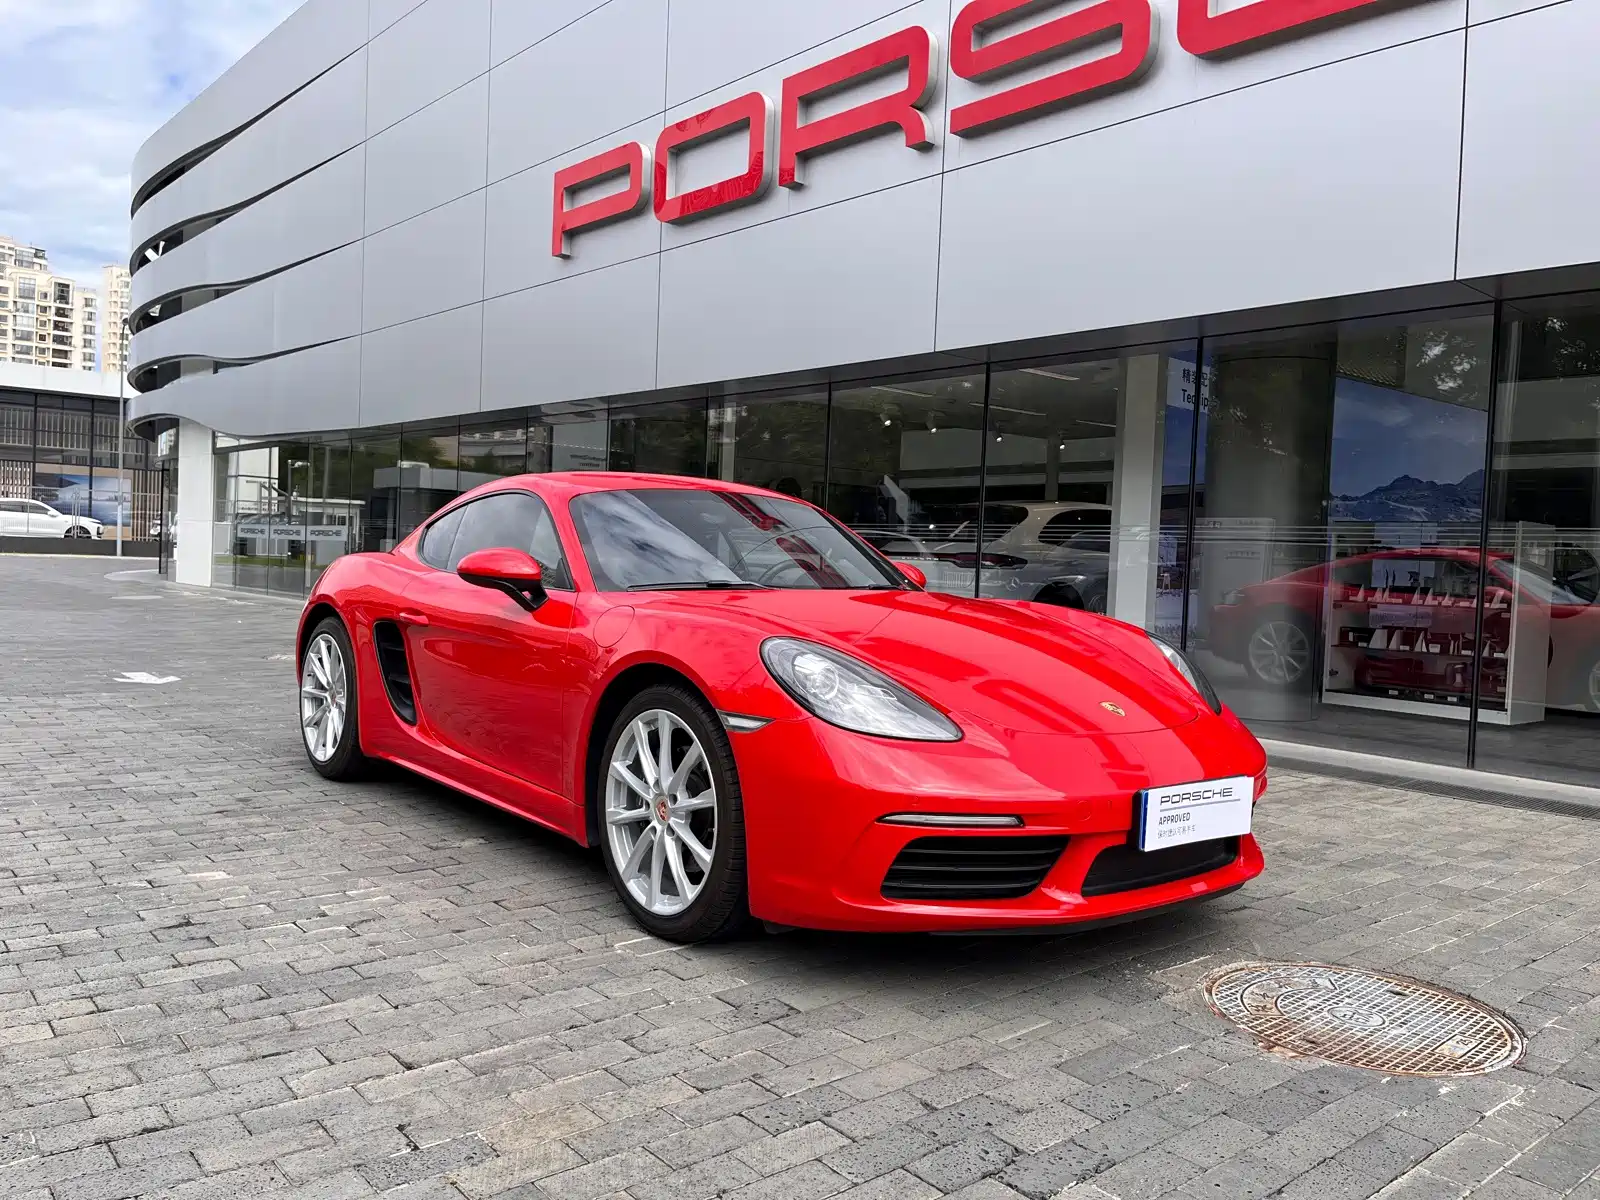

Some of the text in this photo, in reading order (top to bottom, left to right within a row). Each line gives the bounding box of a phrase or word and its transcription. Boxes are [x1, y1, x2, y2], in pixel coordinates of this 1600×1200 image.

[273, 528, 301, 536] PORSCHE
[309, 529, 342, 537] PORSCHE
[1160, 788, 1232, 805] PORSCHE
[1159, 812, 1191, 825] APPROVED
